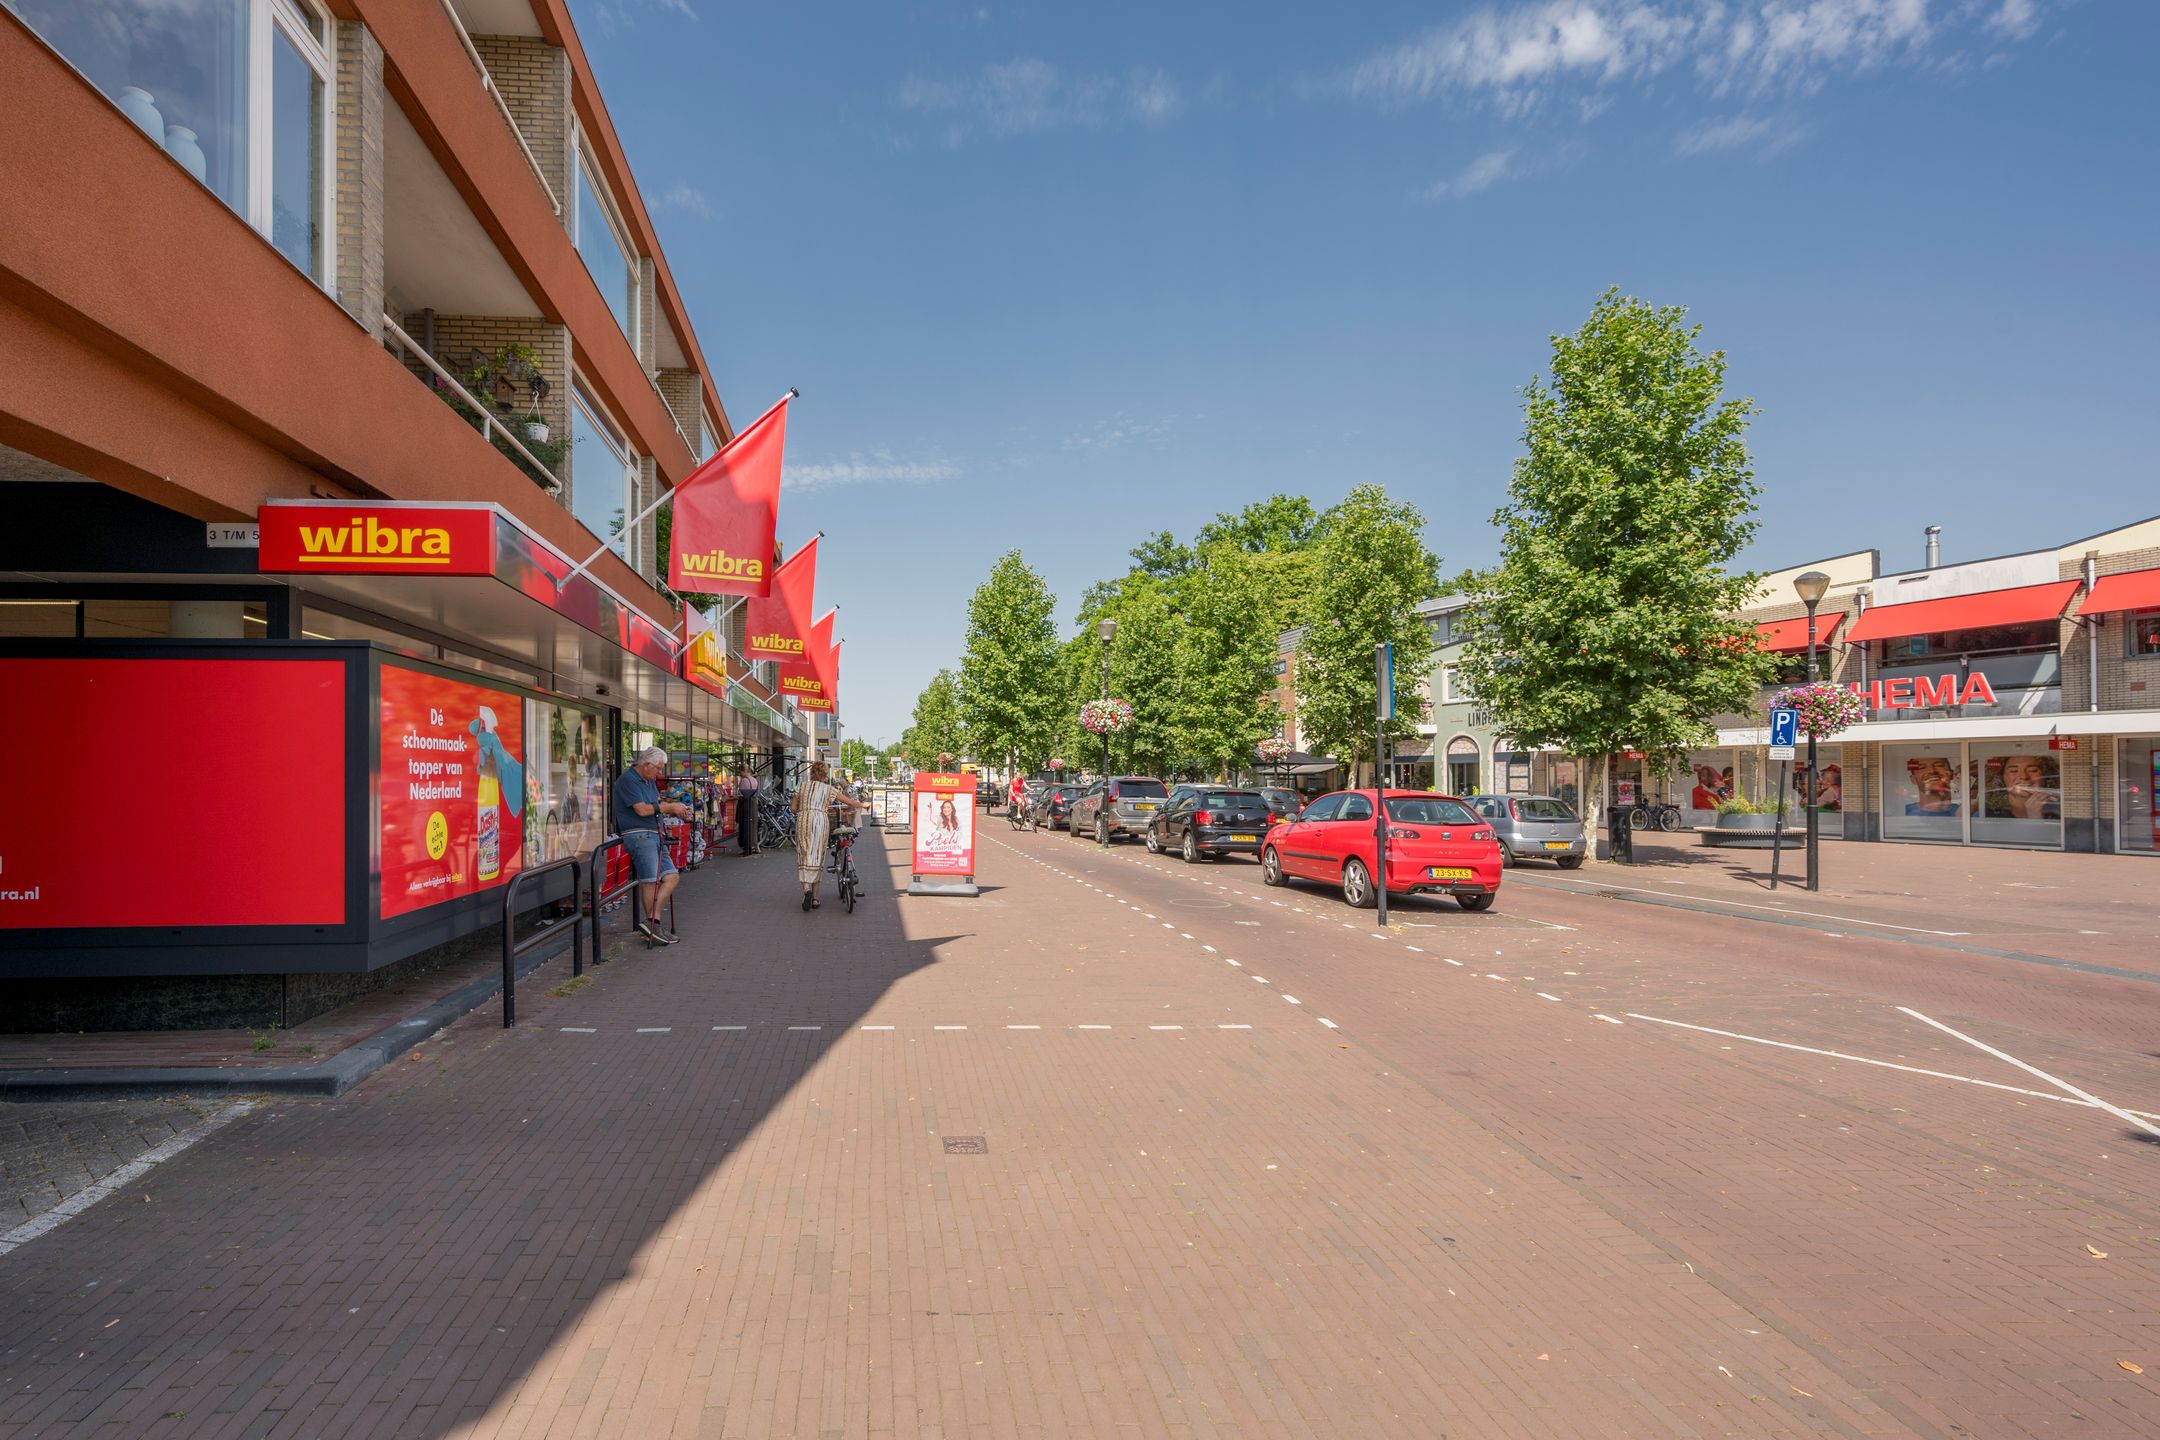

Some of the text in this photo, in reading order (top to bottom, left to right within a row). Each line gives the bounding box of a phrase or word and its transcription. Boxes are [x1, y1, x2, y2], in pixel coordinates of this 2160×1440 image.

[209, 530, 217, 540] 3
[223, 530, 245, 540] T/M
[299, 517, 450, 554] wibra
[682, 550, 763, 576] wibra
[752, 634, 803, 650] wibra
[783, 676, 821, 690] wibra
[1850, 672, 1998, 710] HEMA
[801, 696, 831, 707] wibra
[430, 708, 444, 726] Dé
[1776, 712, 1791, 731] P
[402, 730, 468, 752] schoonmaak-
[2059, 741, 2076, 750] HEMA
[408, 758, 463, 780] topper van
[932, 776, 960, 785] wibra
[410, 781, 462, 800] Nederland
[432, 821, 440, 831] De
